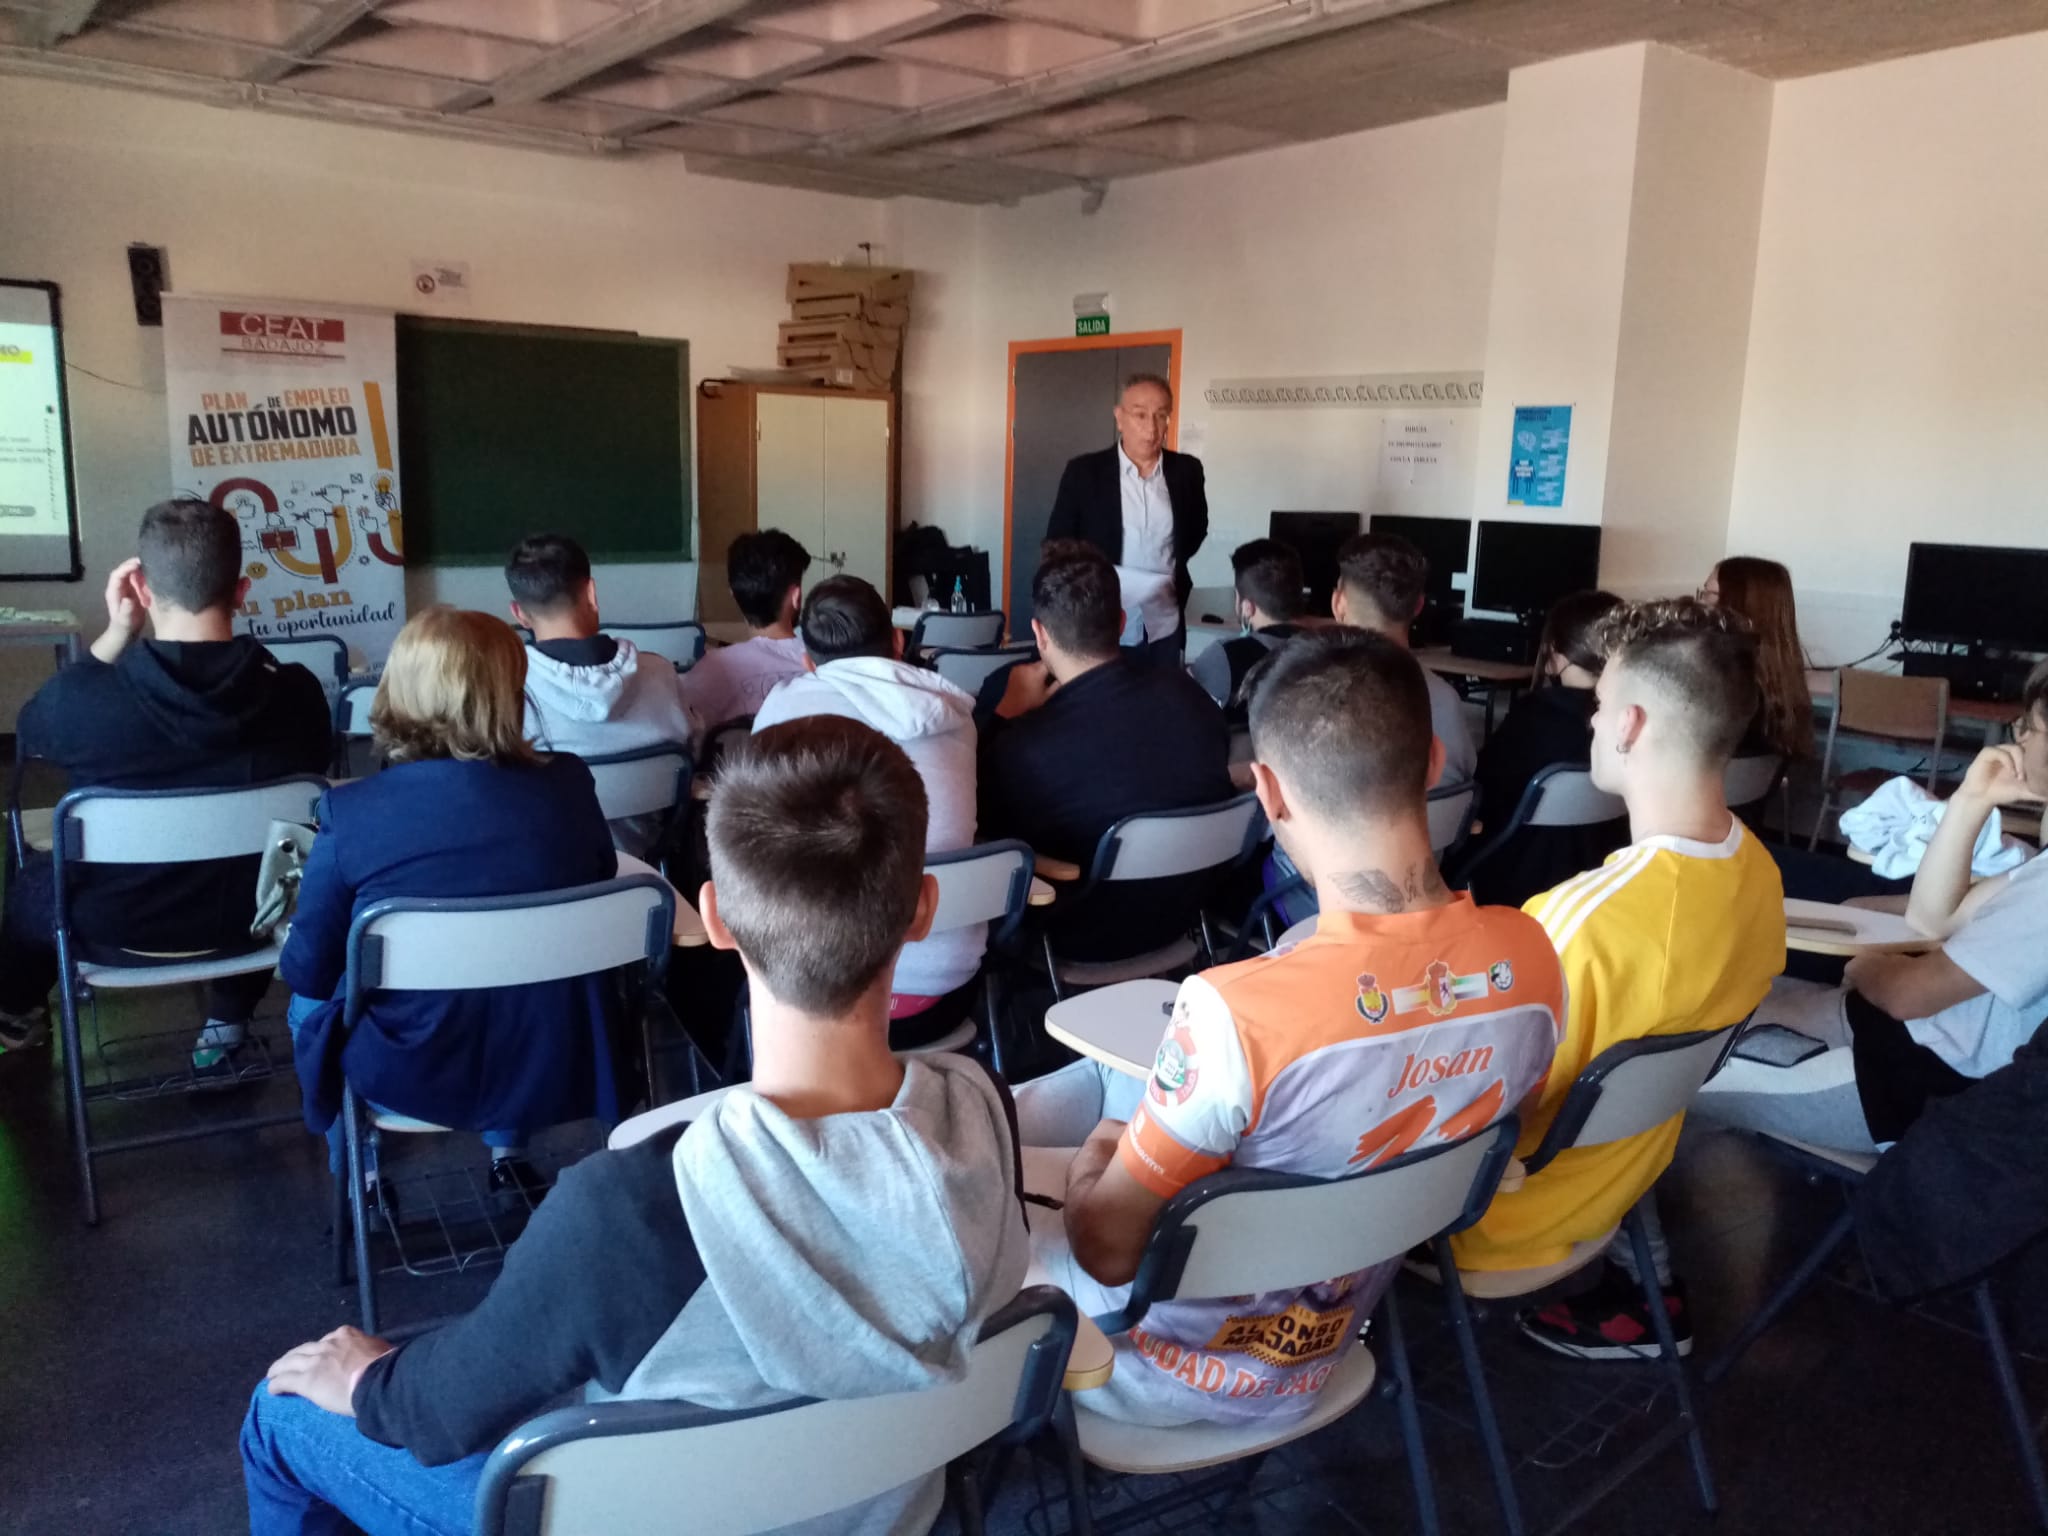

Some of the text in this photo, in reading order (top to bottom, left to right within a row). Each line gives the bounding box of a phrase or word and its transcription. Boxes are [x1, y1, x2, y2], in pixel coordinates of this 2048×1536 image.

[240, 313, 325, 341] CEAT
[1077, 319, 1106, 335] SALIDA
[201, 387, 351, 411] PLAN DE EMPLEO
[188, 403, 358, 446] AUTÓNOMO
[191, 437, 362, 468] DE EXTREMADURA
[272, 589, 353, 619] plan
[247, 602, 398, 638] tu oportunidad
[1387, 1045, 1495, 1099] Josan
